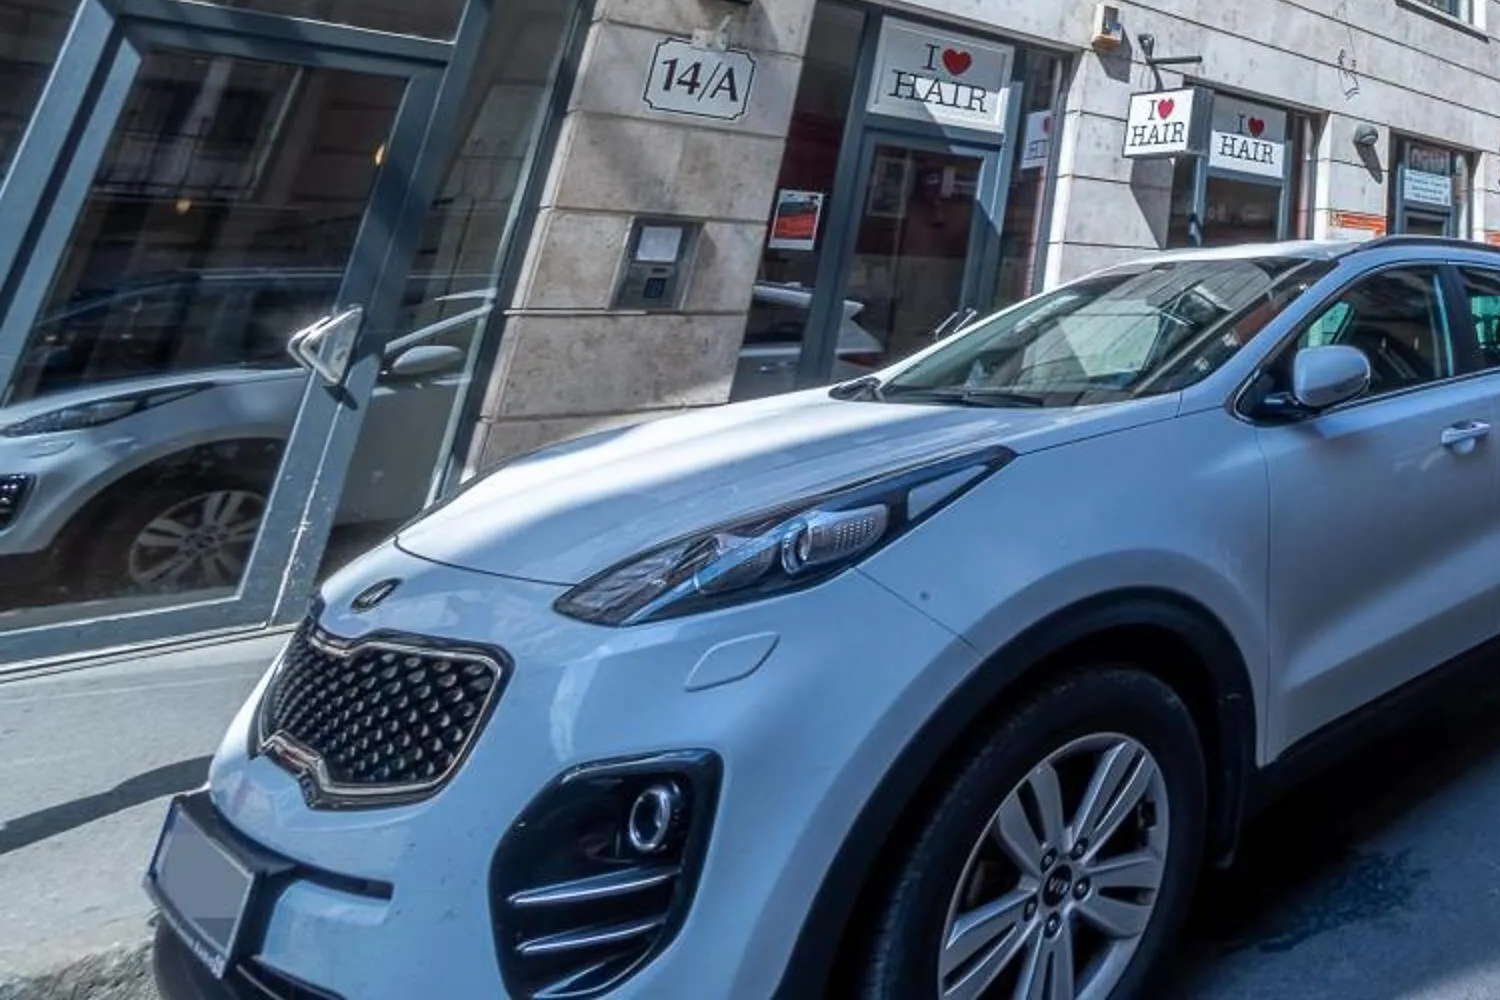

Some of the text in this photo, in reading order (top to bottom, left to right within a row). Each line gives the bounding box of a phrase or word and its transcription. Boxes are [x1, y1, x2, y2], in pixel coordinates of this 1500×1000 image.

[922, 42, 940, 71] I
[662, 57, 738, 102] 14/A
[888, 69, 988, 113] HAIR
[1147, 99, 1158, 121] I
[1236, 112, 1246, 135] I
[1128, 121, 1185, 147] HAIR
[1218, 135, 1275, 165] HAIR
